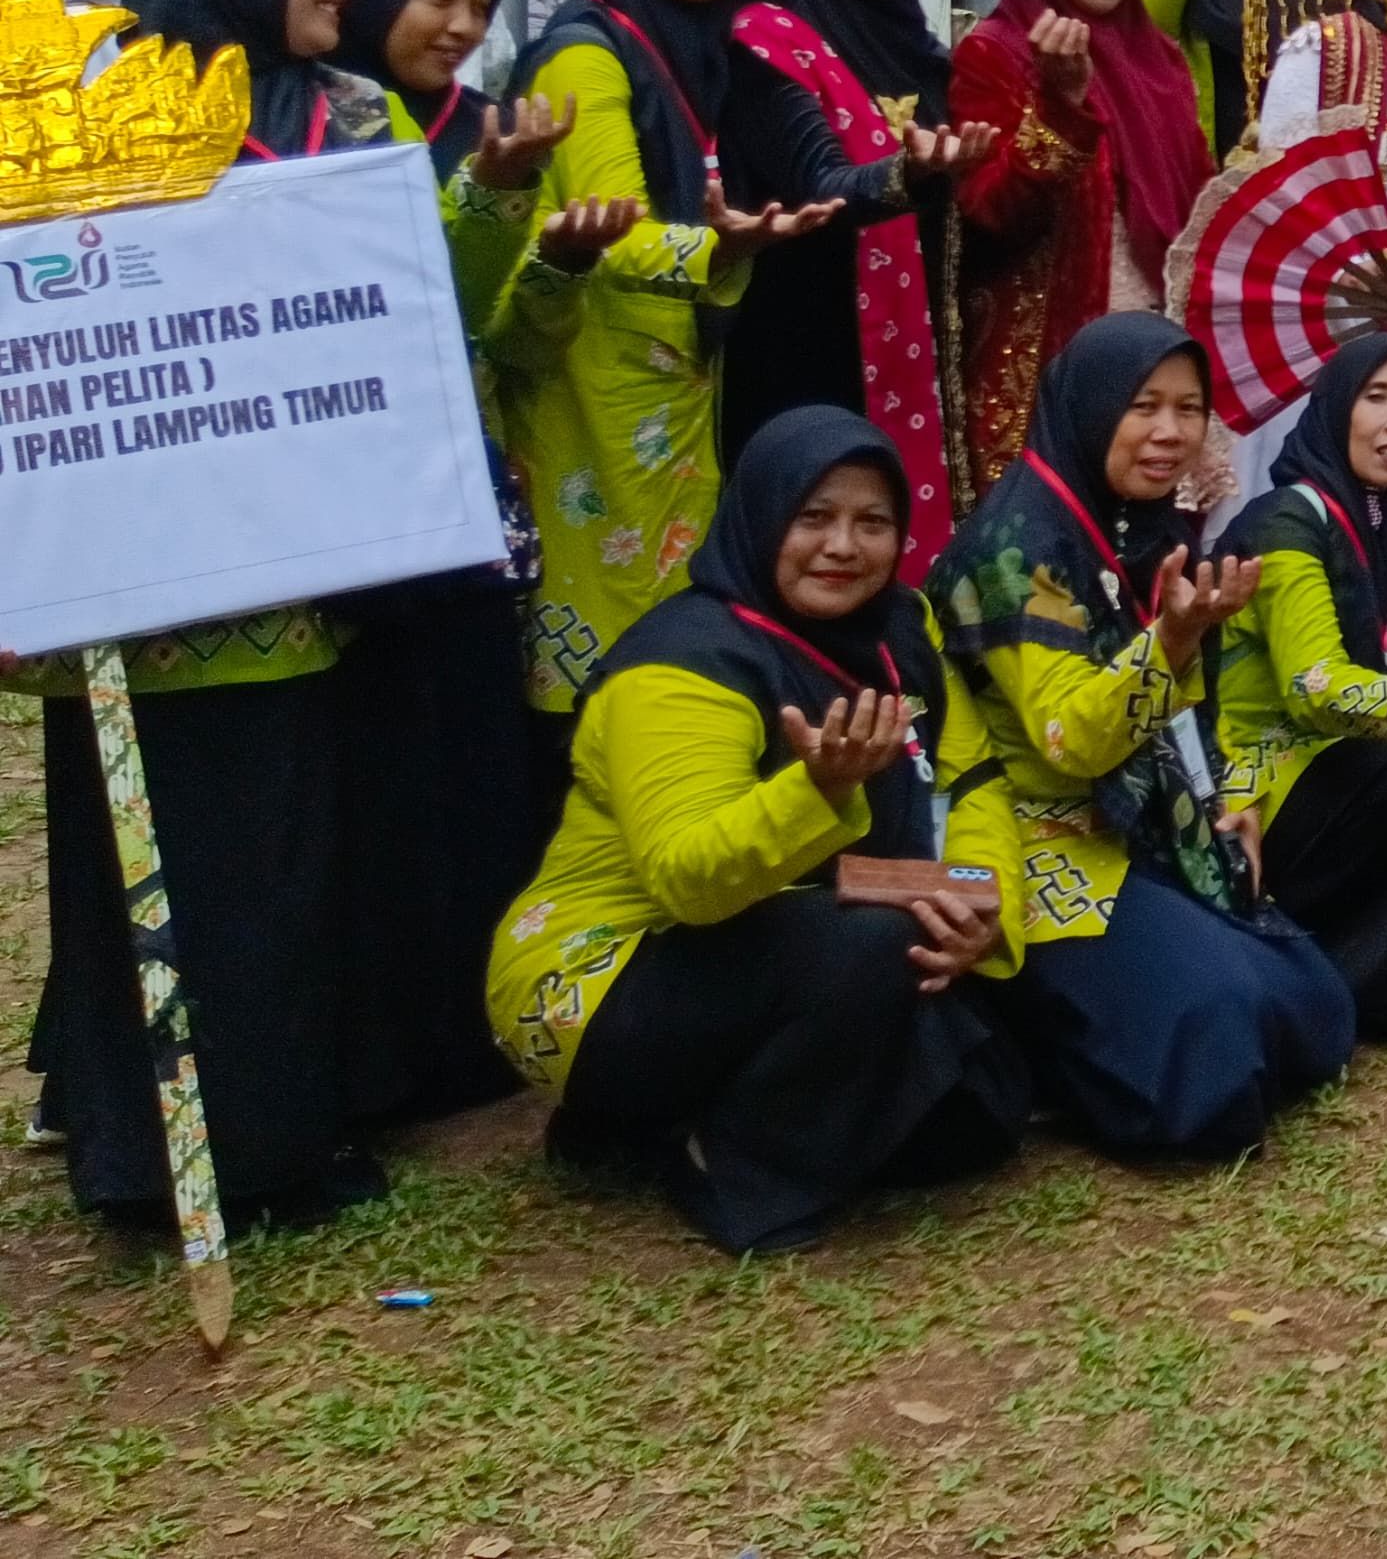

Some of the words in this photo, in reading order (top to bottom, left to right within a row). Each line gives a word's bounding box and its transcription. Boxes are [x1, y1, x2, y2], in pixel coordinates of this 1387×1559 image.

[148, 301, 260, 352] LINTAS
[272, 283, 390, 330] AGAMA
[0, 378, 72, 426] HAN
[81, 360, 194, 412] PELITA
[13, 422, 105, 473] IPARI
[112, 394, 276, 456] LAMPUNG
[283, 375, 389, 428] TIMUR
